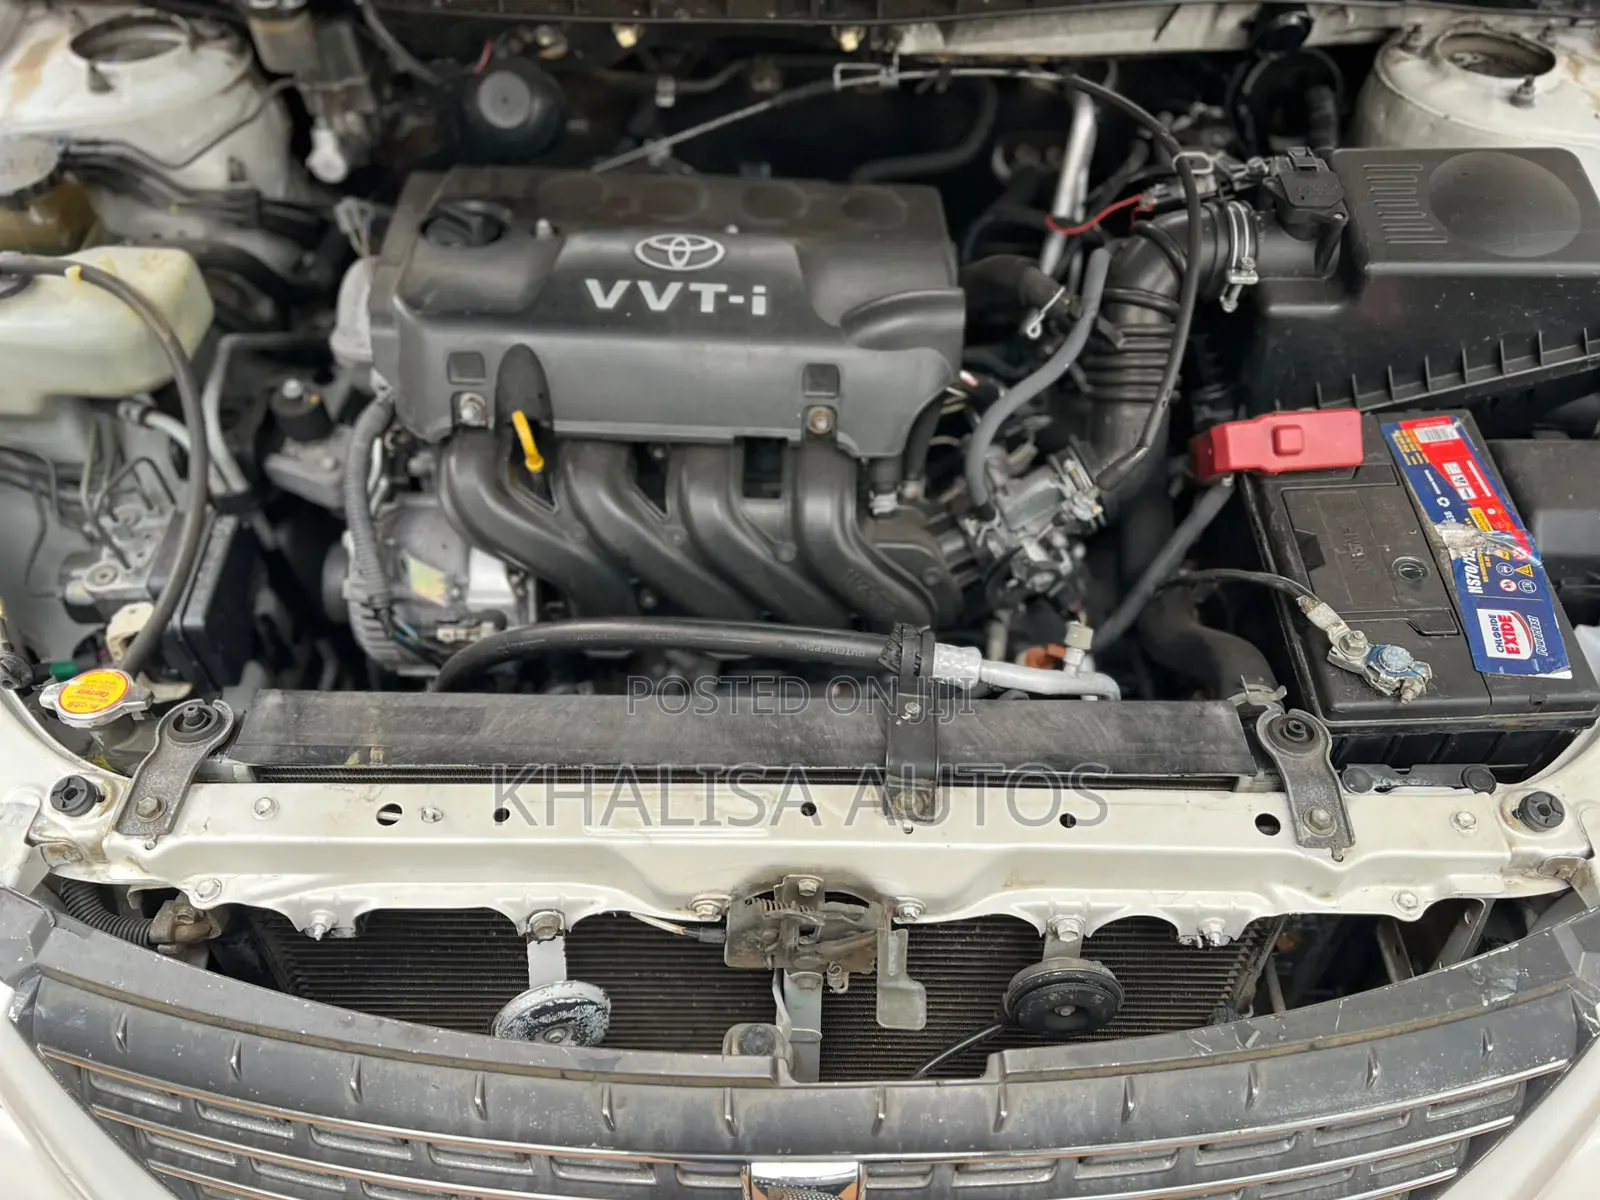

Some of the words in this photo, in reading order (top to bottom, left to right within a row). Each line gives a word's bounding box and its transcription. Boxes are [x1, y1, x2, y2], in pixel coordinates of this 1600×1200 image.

[585, 278, 767, 316] VVT-i
[1487, 613, 1505, 654] CHLORIDE
[1497, 613, 1521, 655] EXIDE
